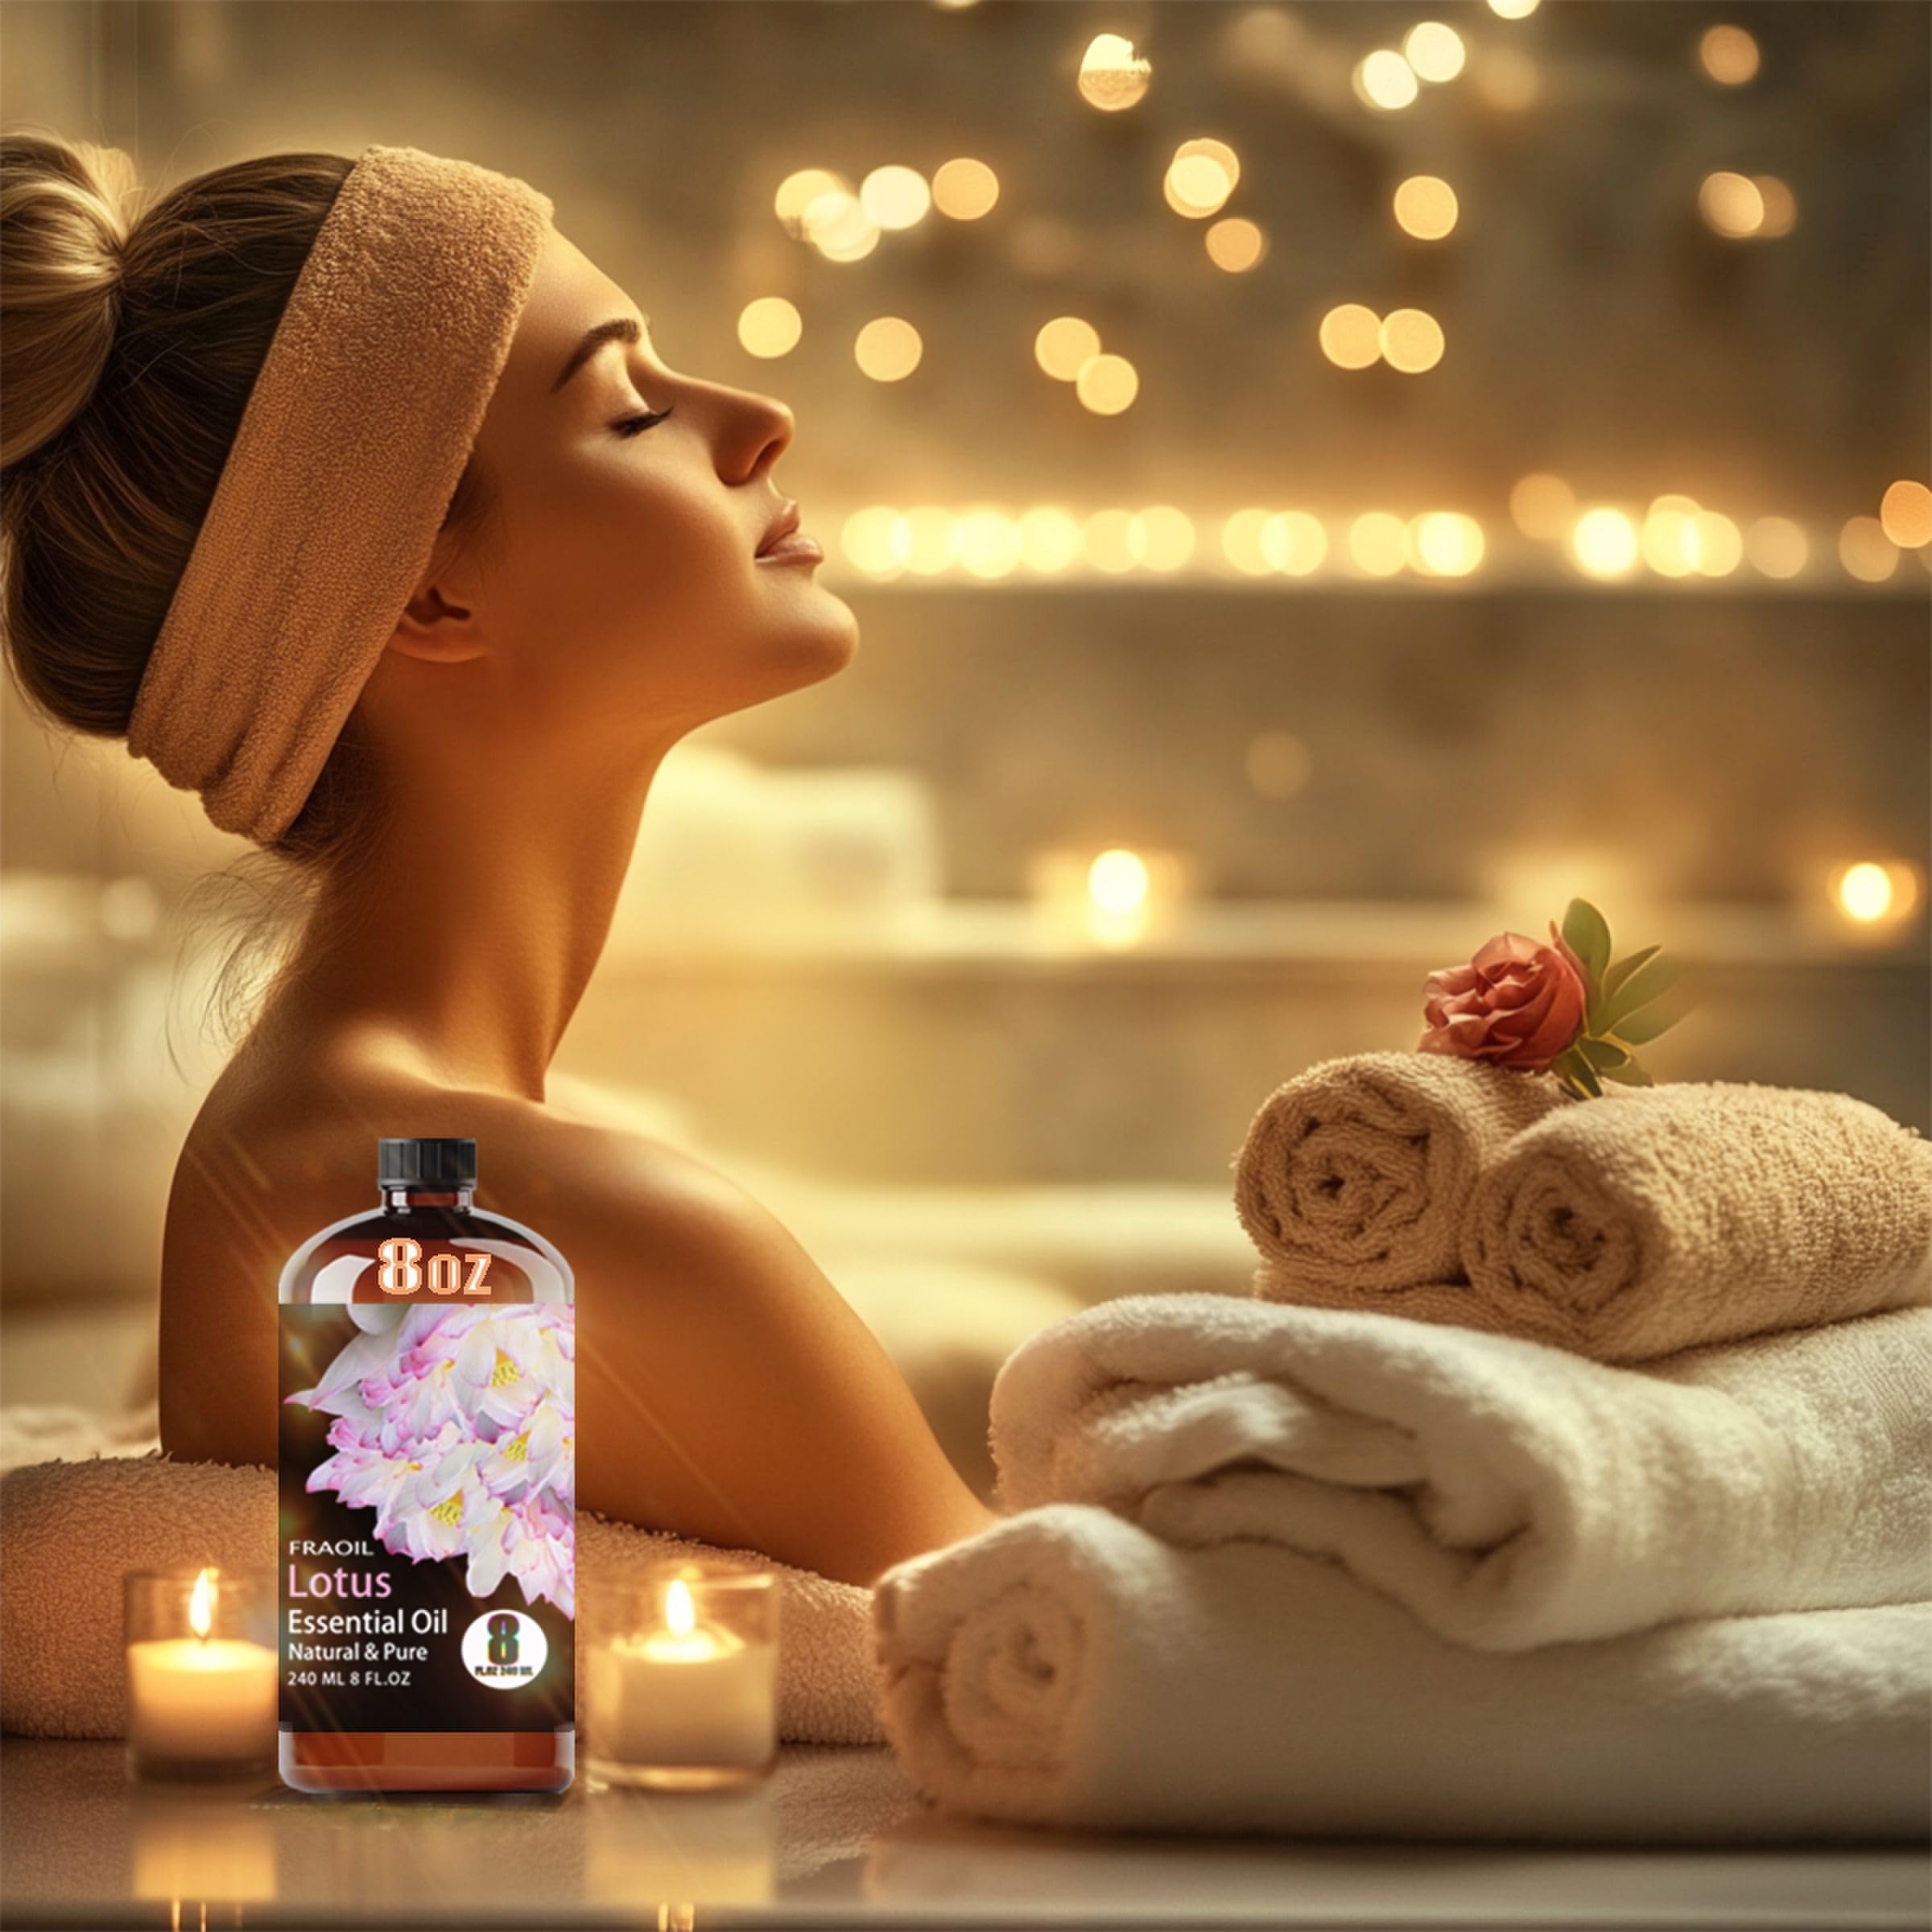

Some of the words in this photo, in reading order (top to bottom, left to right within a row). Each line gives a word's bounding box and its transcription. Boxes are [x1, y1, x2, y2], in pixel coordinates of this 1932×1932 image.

[288, 1540, 374, 1556] FRAOIL
[288, 1564, 392, 1598] Lotus
[288, 1608, 403, 1634] Essential
[411, 1608, 448, 1634] Oil
[487, 1613, 520, 1666] 8
[288, 1642, 359, 1661] Natural
[364, 1643, 378, 1661] &
[383, 1643, 427, 1661] Pure
[287, 1670, 317, 1686] 240
[321, 1670, 345, 1686] ML
[349, 1670, 360, 1686] 8
[365, 1670, 411, 1686] FL.OZ
